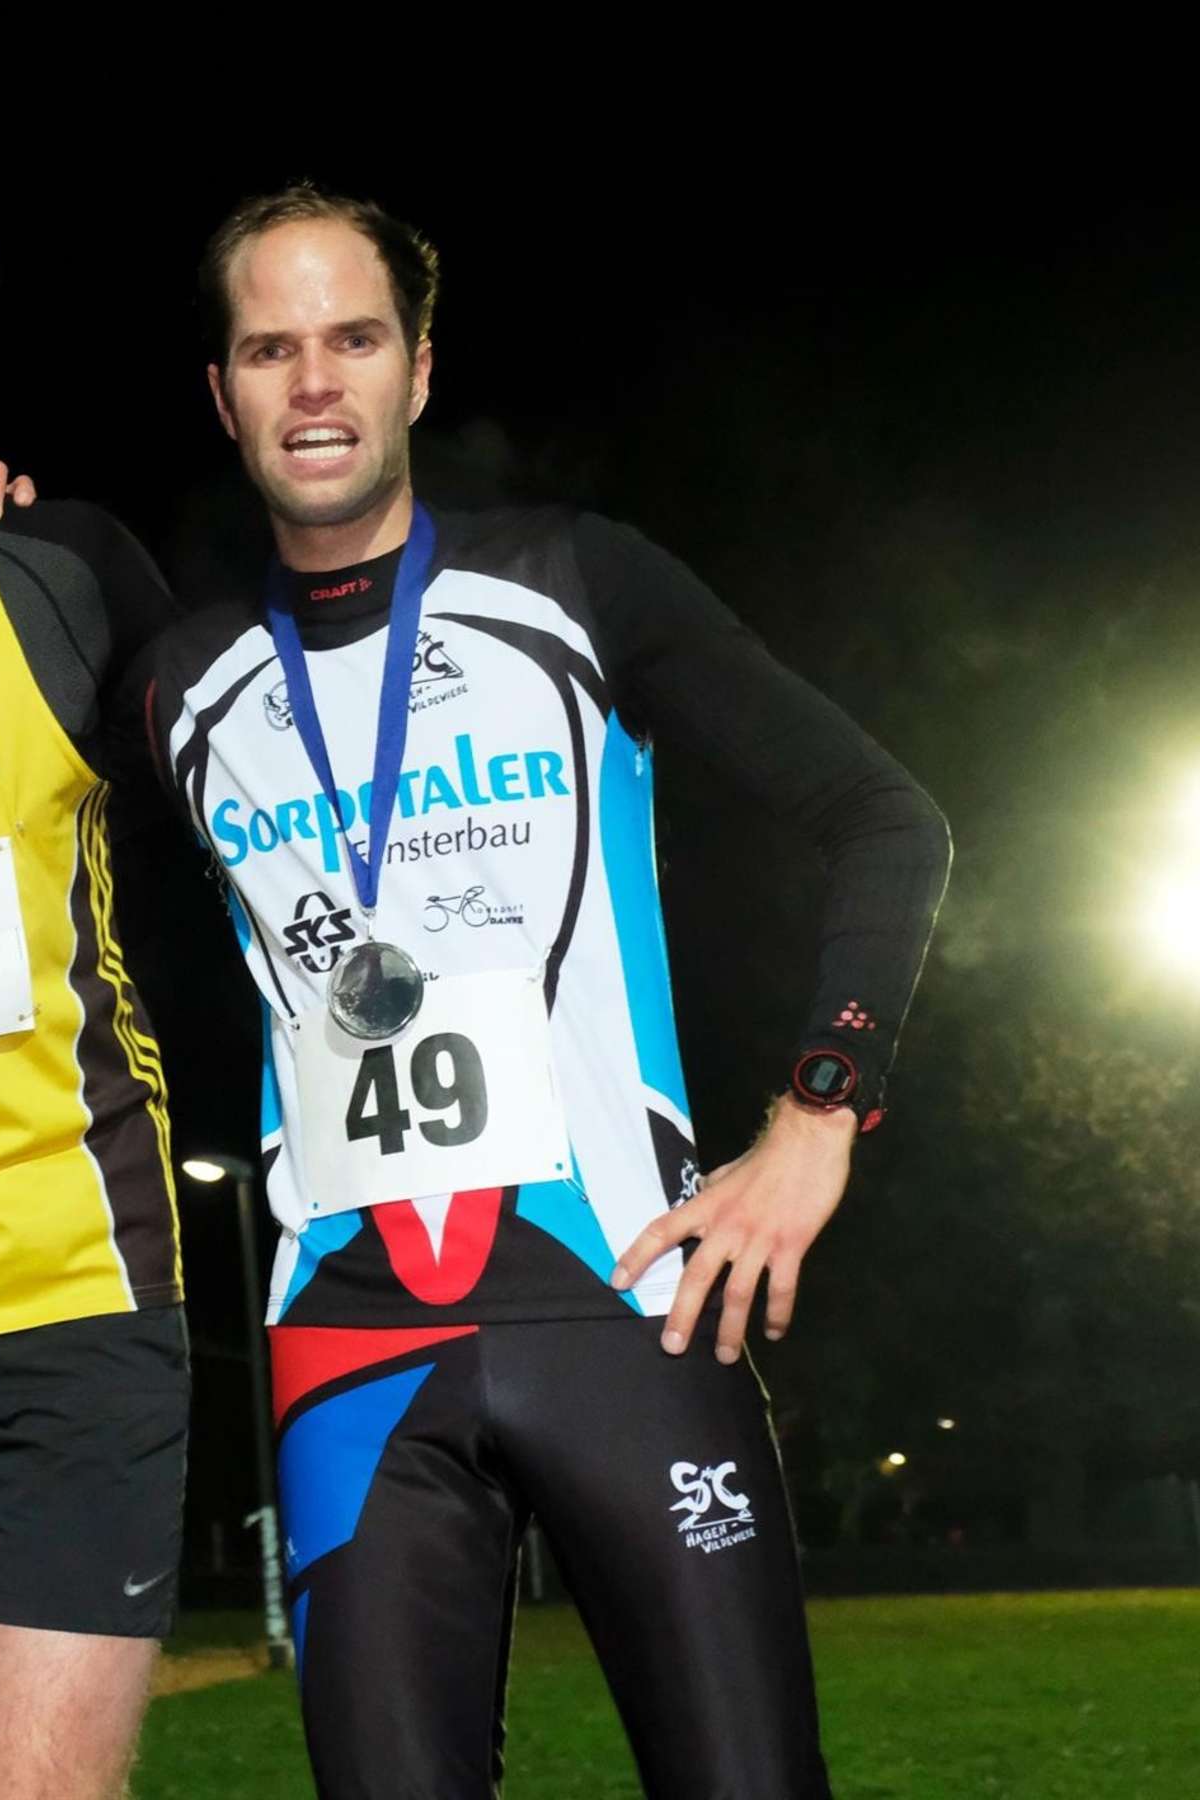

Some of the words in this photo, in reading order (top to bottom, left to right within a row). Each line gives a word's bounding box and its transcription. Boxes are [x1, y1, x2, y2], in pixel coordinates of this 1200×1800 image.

[310, 581, 357, 601] CRAFT
[353, 816, 531, 865] Fnsterbau
[283, 907, 356, 957] SKS
[345, 1032, 489, 1155] 49
